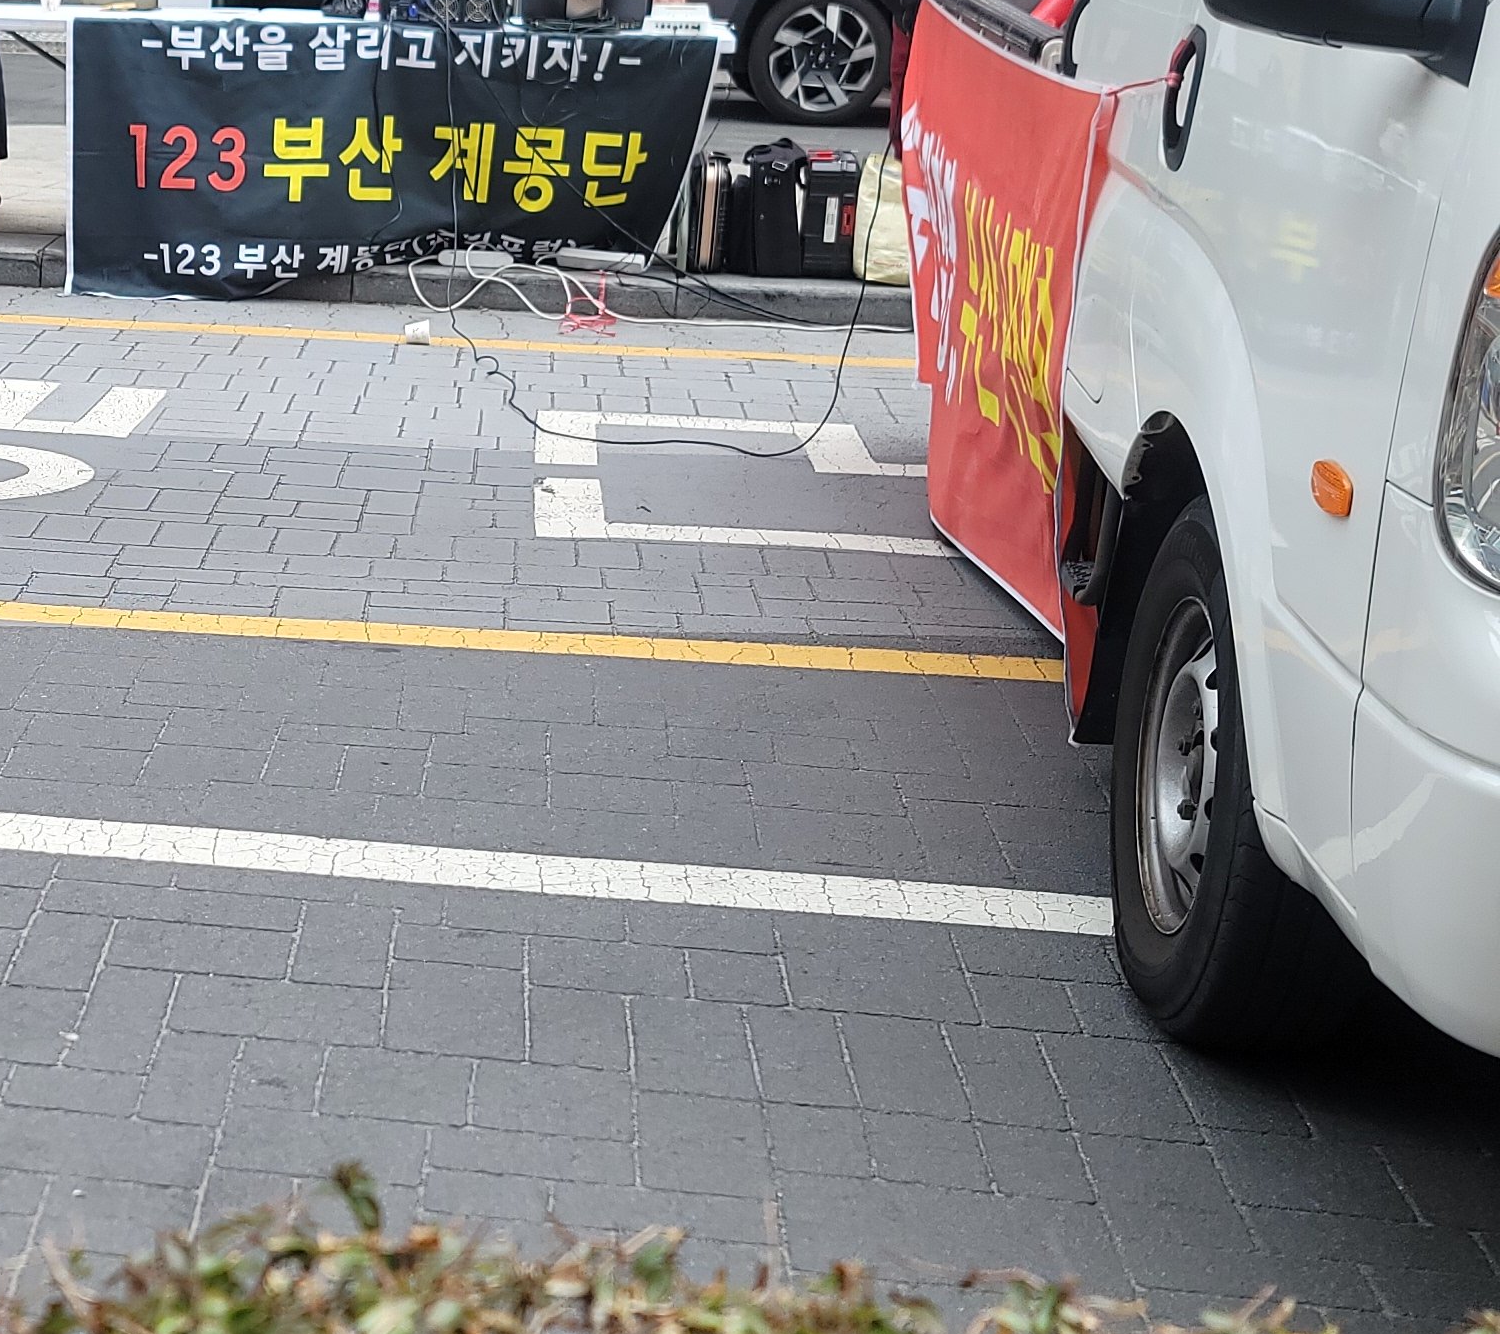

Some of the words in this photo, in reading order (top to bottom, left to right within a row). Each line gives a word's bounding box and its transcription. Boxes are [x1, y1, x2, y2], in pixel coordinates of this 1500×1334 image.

[307, 25, 435, 71] 살리고
[128, 122, 248, 193] 123
[262, 116, 403, 203] 부산
[428, 121, 648, 213] 계몽단
[232, 243, 305, 280] 부산
